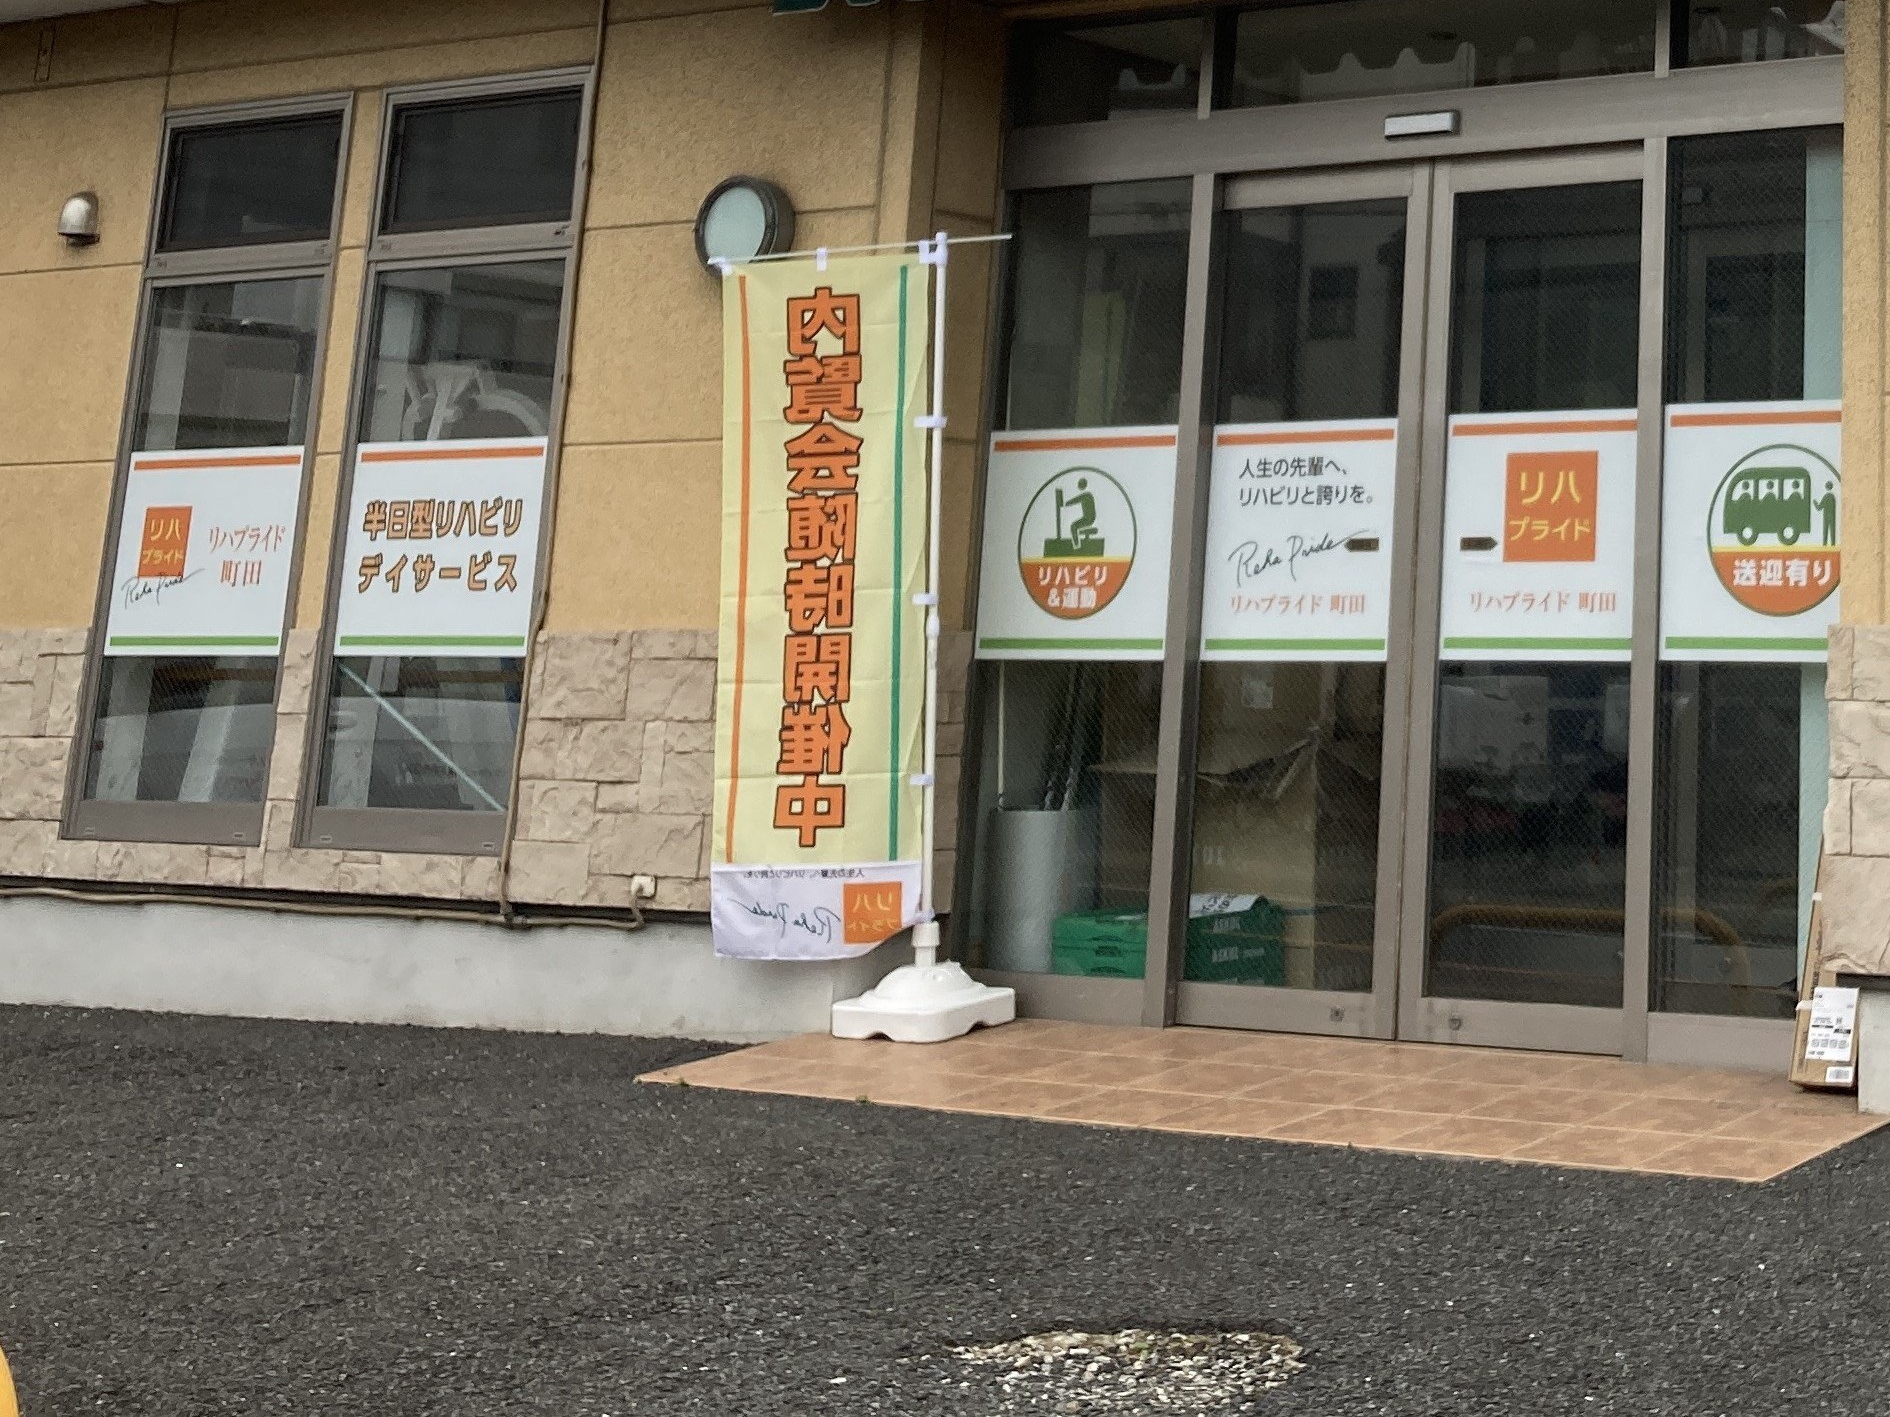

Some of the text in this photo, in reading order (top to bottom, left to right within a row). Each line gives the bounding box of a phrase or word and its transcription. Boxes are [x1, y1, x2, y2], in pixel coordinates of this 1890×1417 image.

[1239, 456, 1347, 478] 人生の先輩へ、
[1239, 484, 1373, 507] リハビリと誇りを。
[1519, 470, 1581, 505] リハ
[150, 518, 180, 540] リハ
[363, 498, 523, 540] 半日型リハビリ
[1508, 516, 1591, 542] プライド
[208, 525, 286, 556] リハプライド
[142, 548, 184, 566] プライド
[220, 559, 261, 587] 町田
[358, 553, 518, 593] デイサービス
[1038, 565, 1108, 586] リハビリ
[1732, 558, 1832, 587] 送迎有り
[1230, 593, 1365, 615] リハプライド 町田
[1469, 591, 1617, 614] リハプライド 町田
